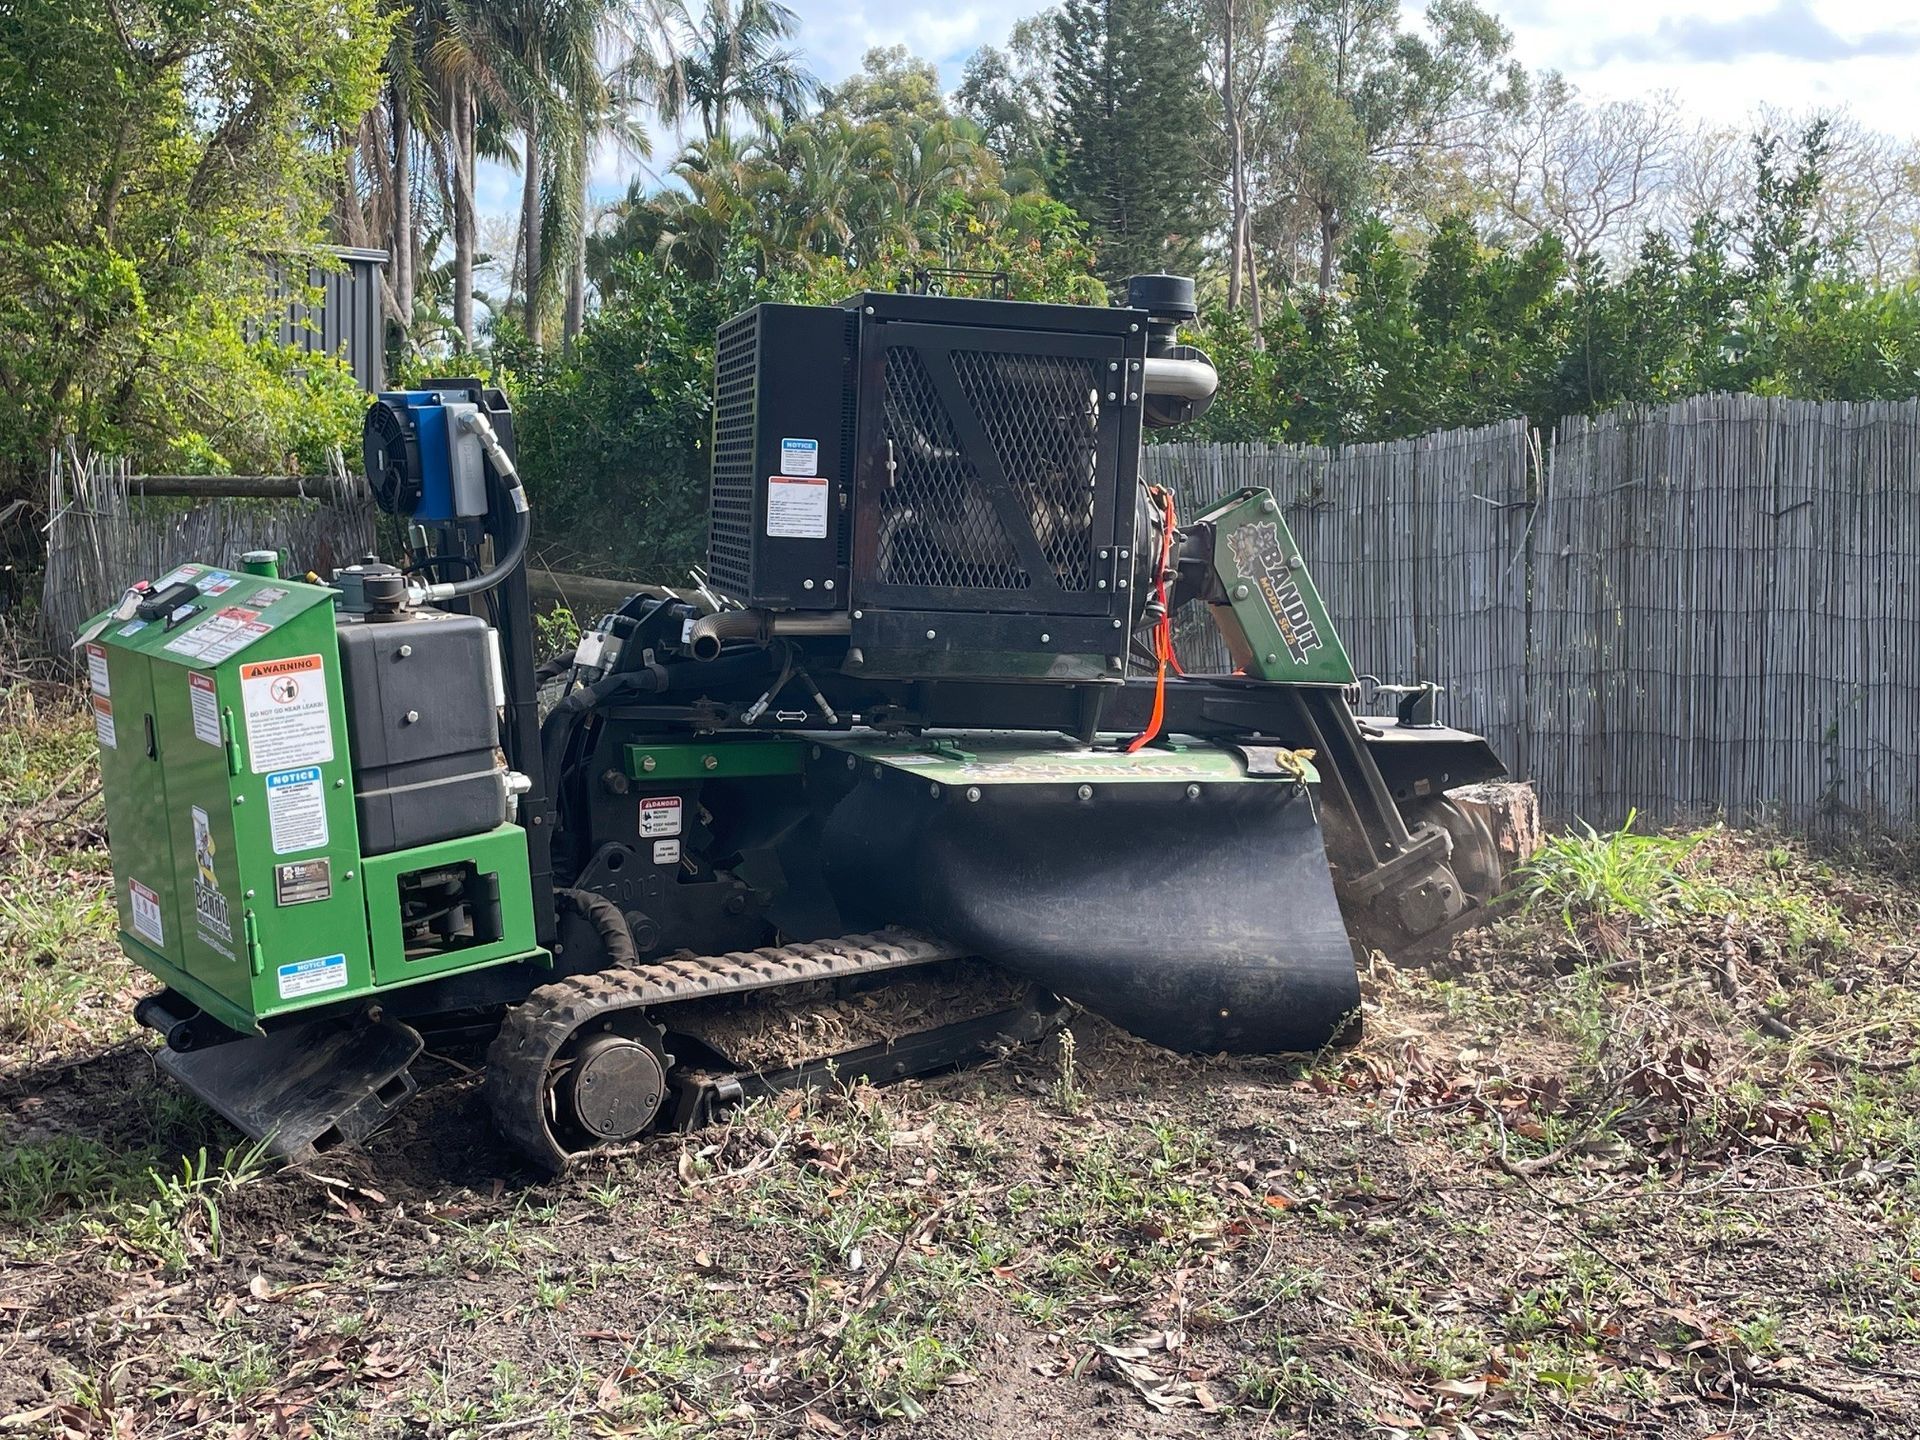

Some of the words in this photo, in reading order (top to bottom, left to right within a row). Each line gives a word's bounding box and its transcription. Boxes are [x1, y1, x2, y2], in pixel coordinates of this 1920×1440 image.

[1260, 547, 1322, 651] BANDIT
[1260, 577, 1283, 616] MODEL
[1278, 617, 1296, 645] SG-75
[263, 660, 313, 674] WARNING
[273, 770, 314, 785] NOTICE
[194, 880, 230, 928] Bandit
[297, 960, 327, 971] NOTICE
